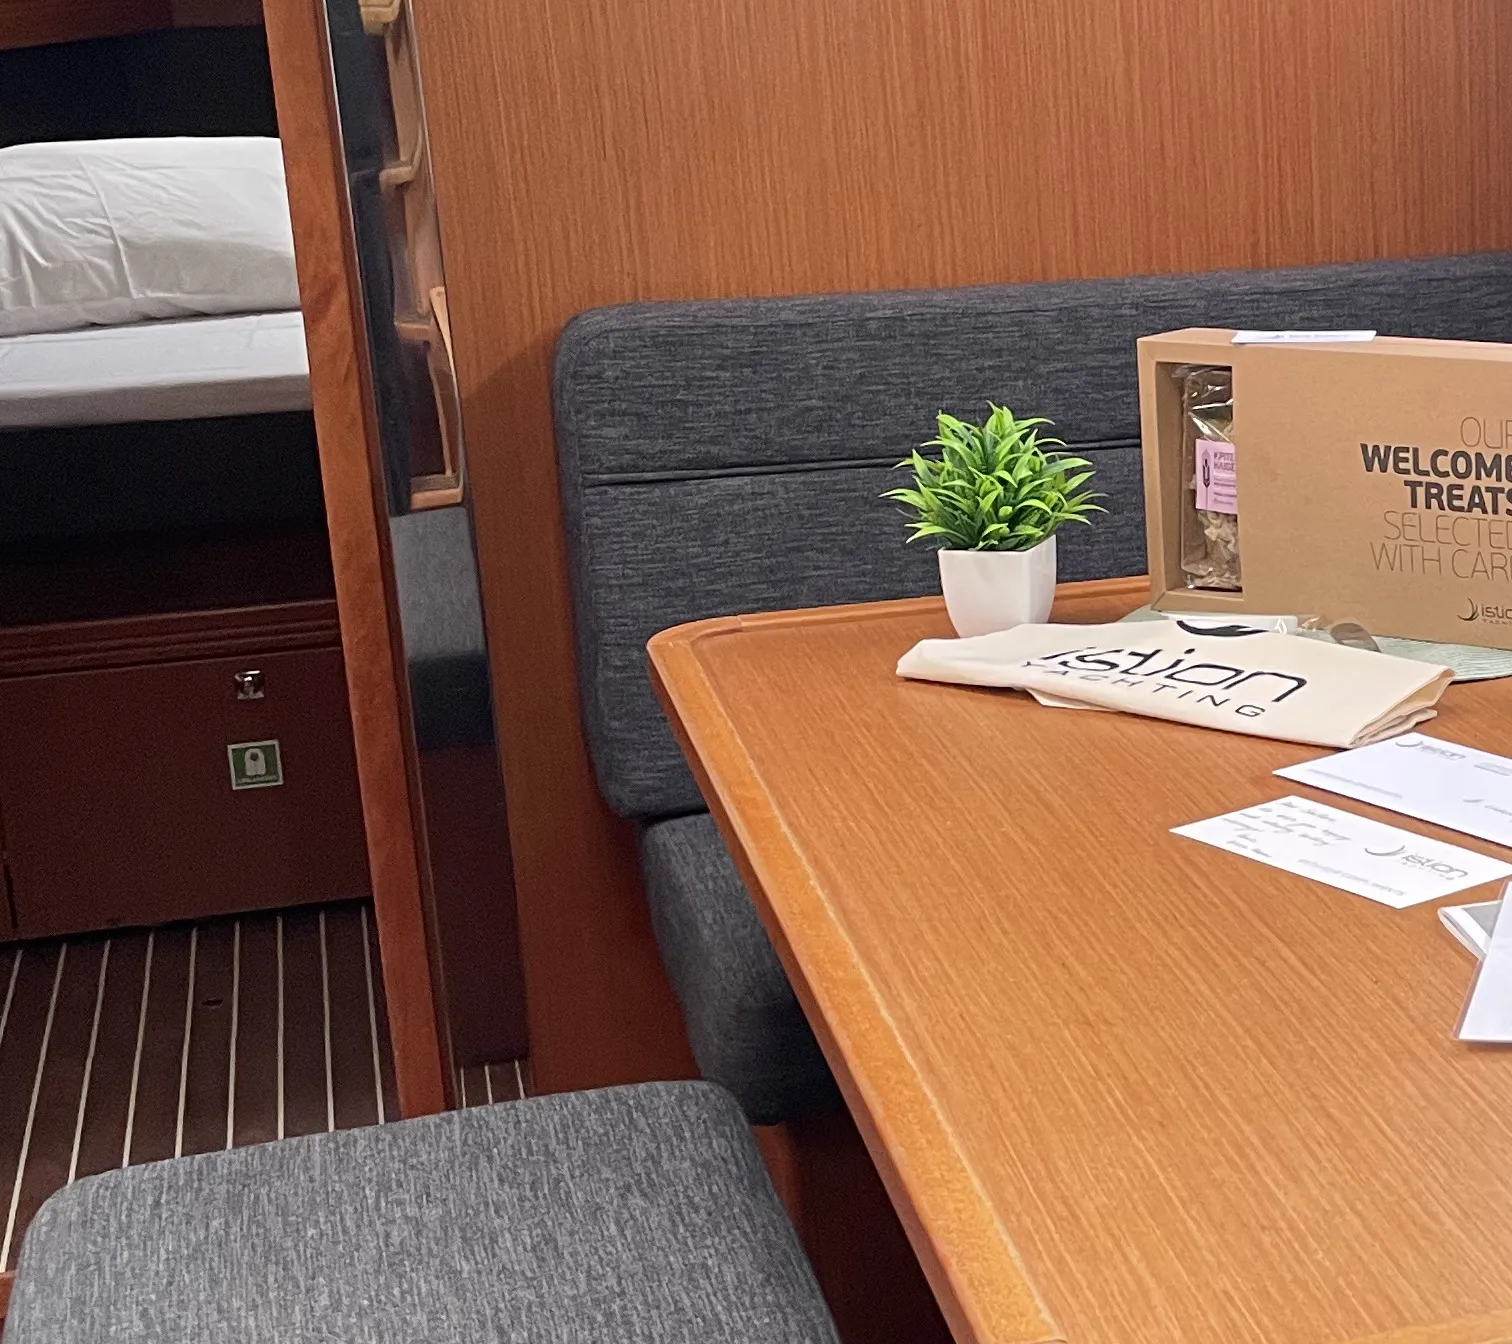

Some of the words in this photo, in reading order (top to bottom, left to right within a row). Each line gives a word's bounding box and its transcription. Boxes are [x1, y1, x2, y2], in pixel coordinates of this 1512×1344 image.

[1370, 541, 1442, 575] WITH
[1021, 659, 1266, 718] YACHTING
[1040, 646, 1308, 704] istion
